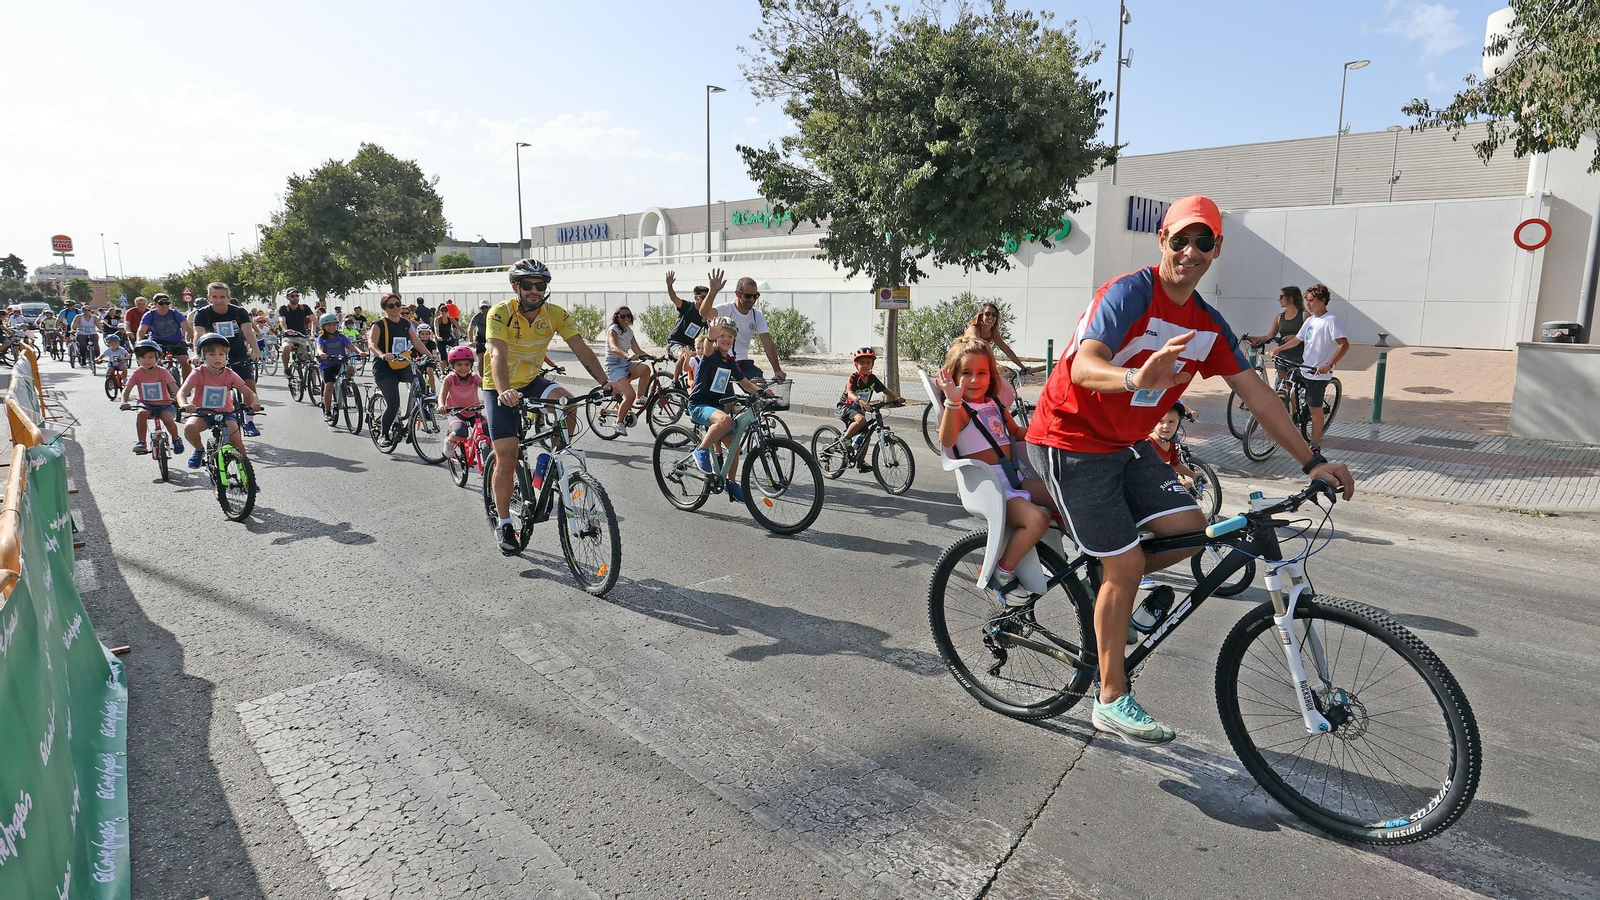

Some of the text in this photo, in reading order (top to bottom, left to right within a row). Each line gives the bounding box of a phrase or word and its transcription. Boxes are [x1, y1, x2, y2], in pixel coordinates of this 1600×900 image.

[556, 222, 608, 243] HIPERCOR
[95, 753, 123, 777] Inglés
[91, 820, 125, 883] El Corte Inglés
